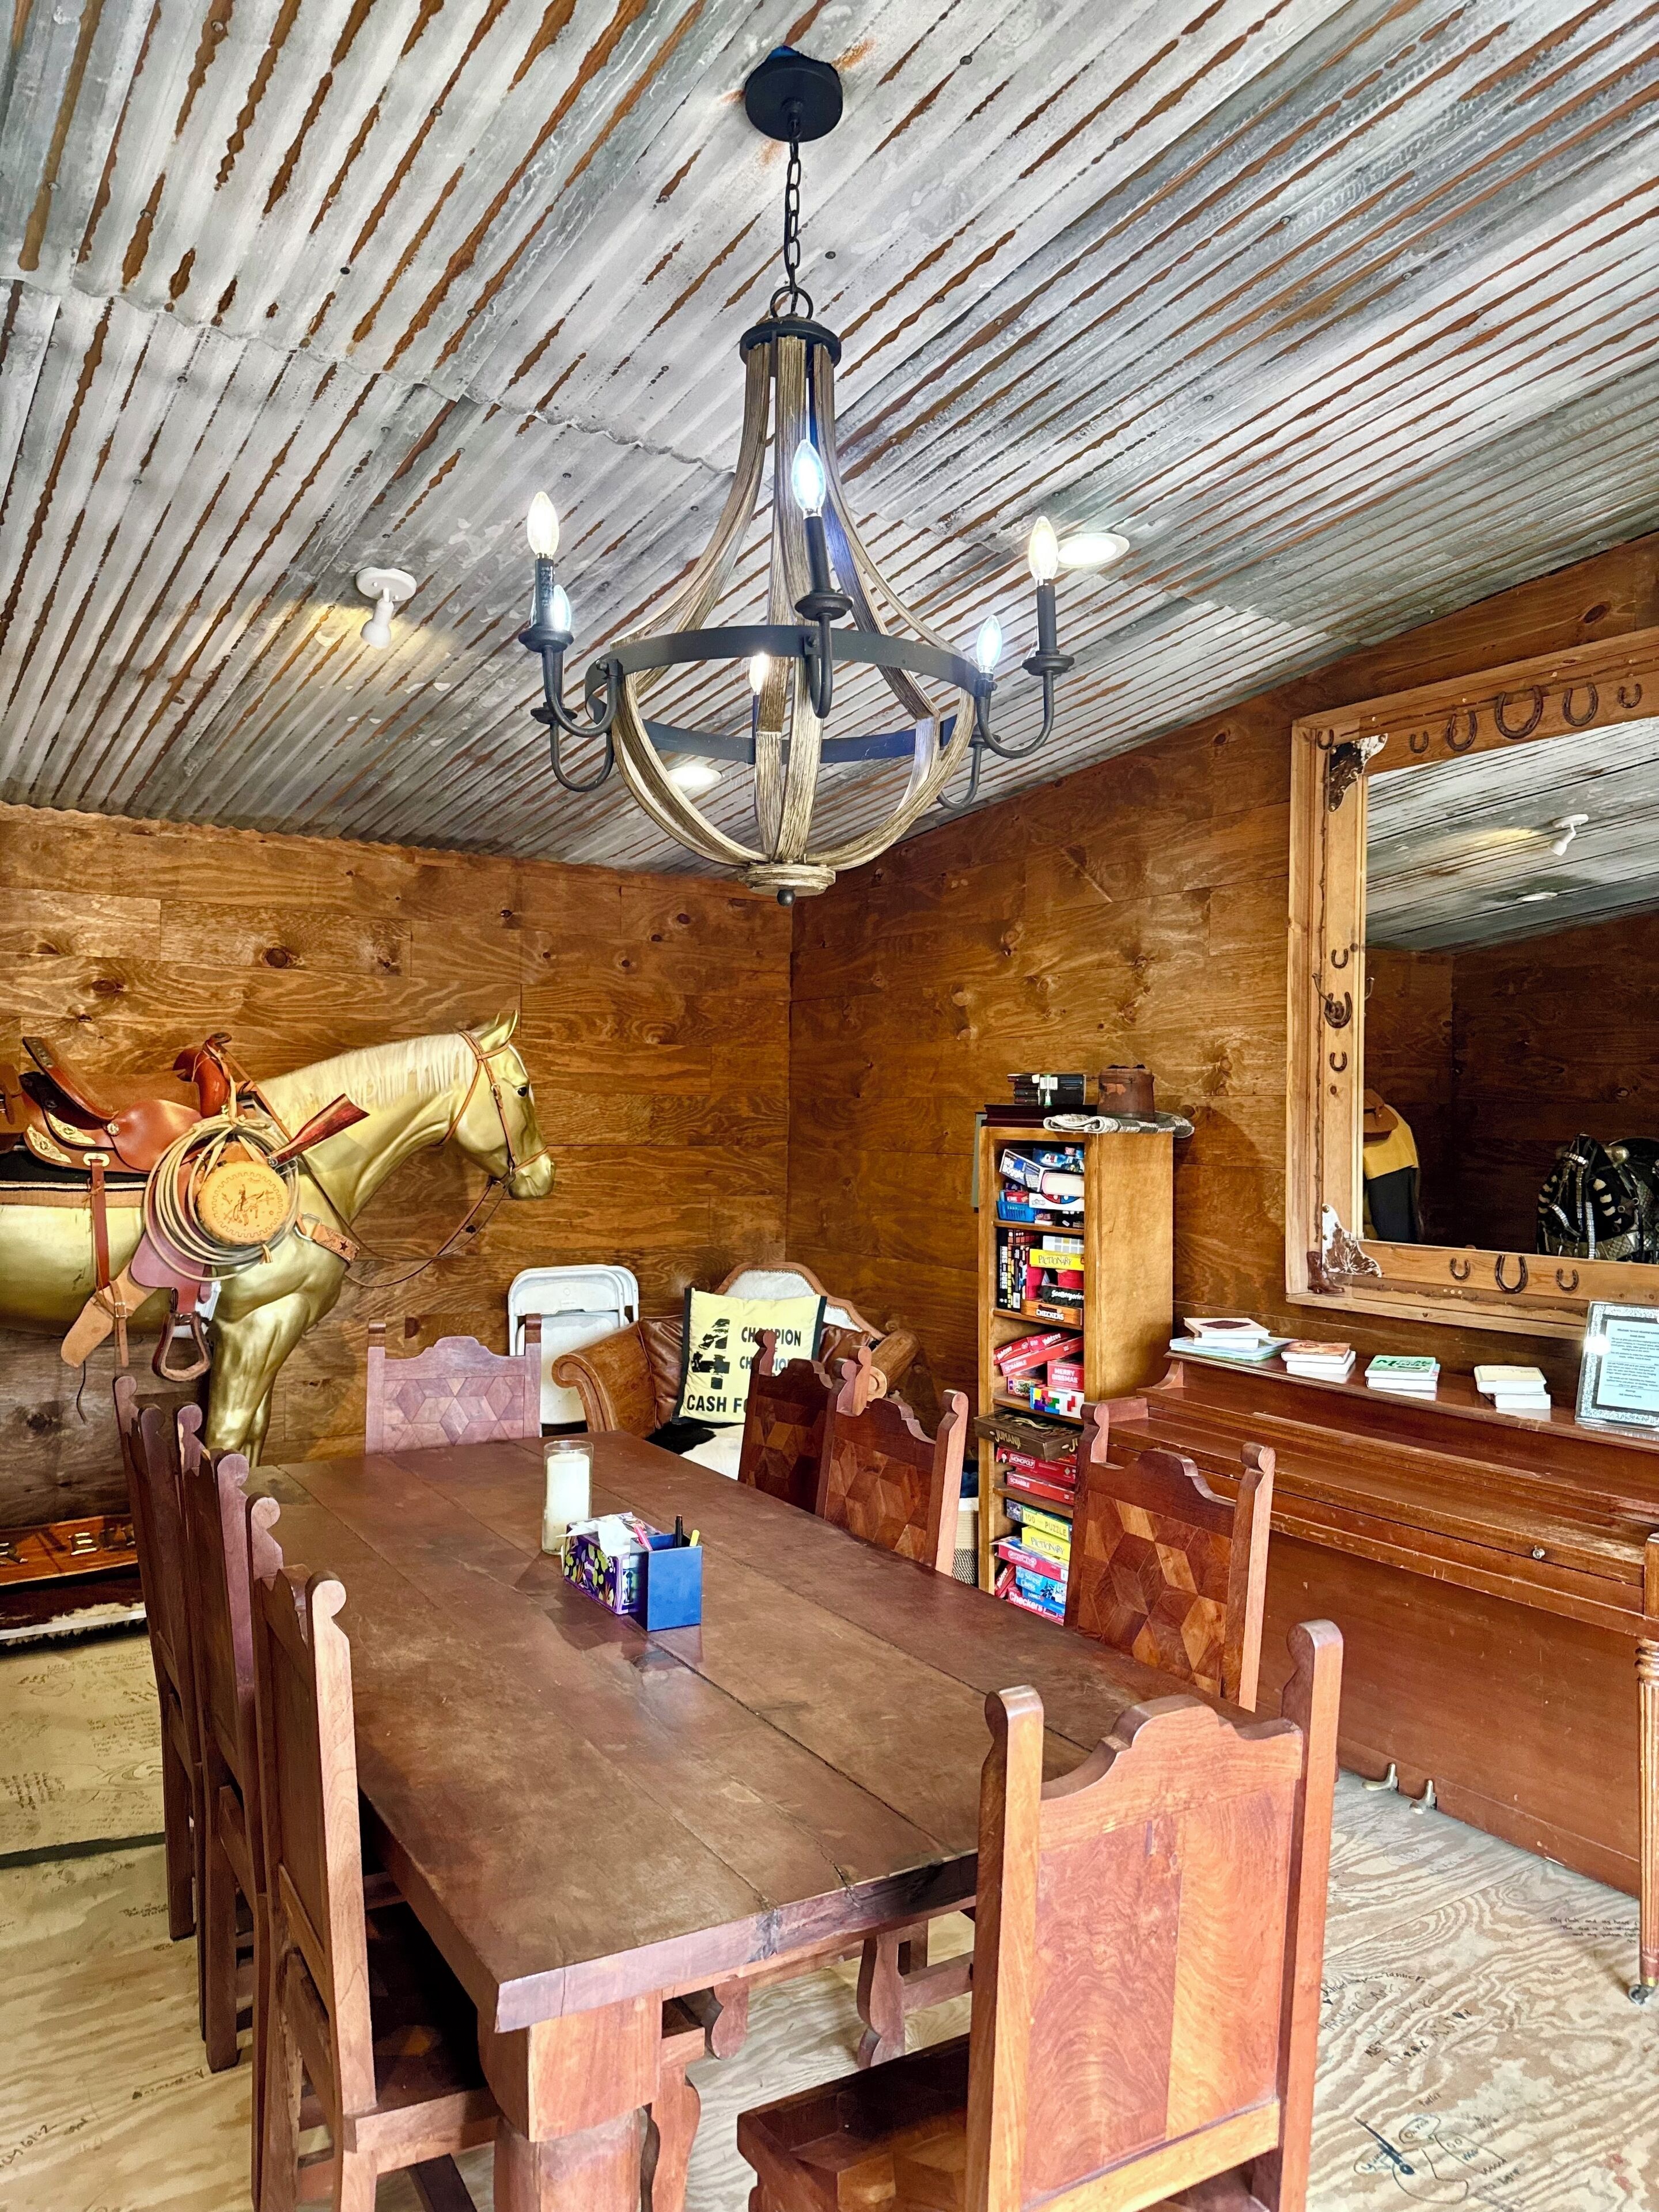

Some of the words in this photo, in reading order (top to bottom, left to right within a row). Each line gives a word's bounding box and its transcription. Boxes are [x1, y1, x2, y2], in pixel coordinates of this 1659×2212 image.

[1038, 1255, 1073, 1266] PICTIONARY
[1036, 1309, 1064, 1320] CHECKERS
[741, 1326, 801, 1347] CHPION
[1005, 1359, 1027, 1373] SCRABBLE
[1054, 1368, 1075, 1376] MERRY
[687, 1394, 727, 1412] CASH
[995, 1429, 1021, 1449] JUMANJI
[1010, 1454, 1035, 1467] MONOPOLY
[1025, 1513, 1036, 1524] 100
[1045, 1521, 1066, 1537] PUZZLE
[1031, 1537, 1064, 1555] PICTIONARY
[1009, 1592, 1043, 1612] Checkers
